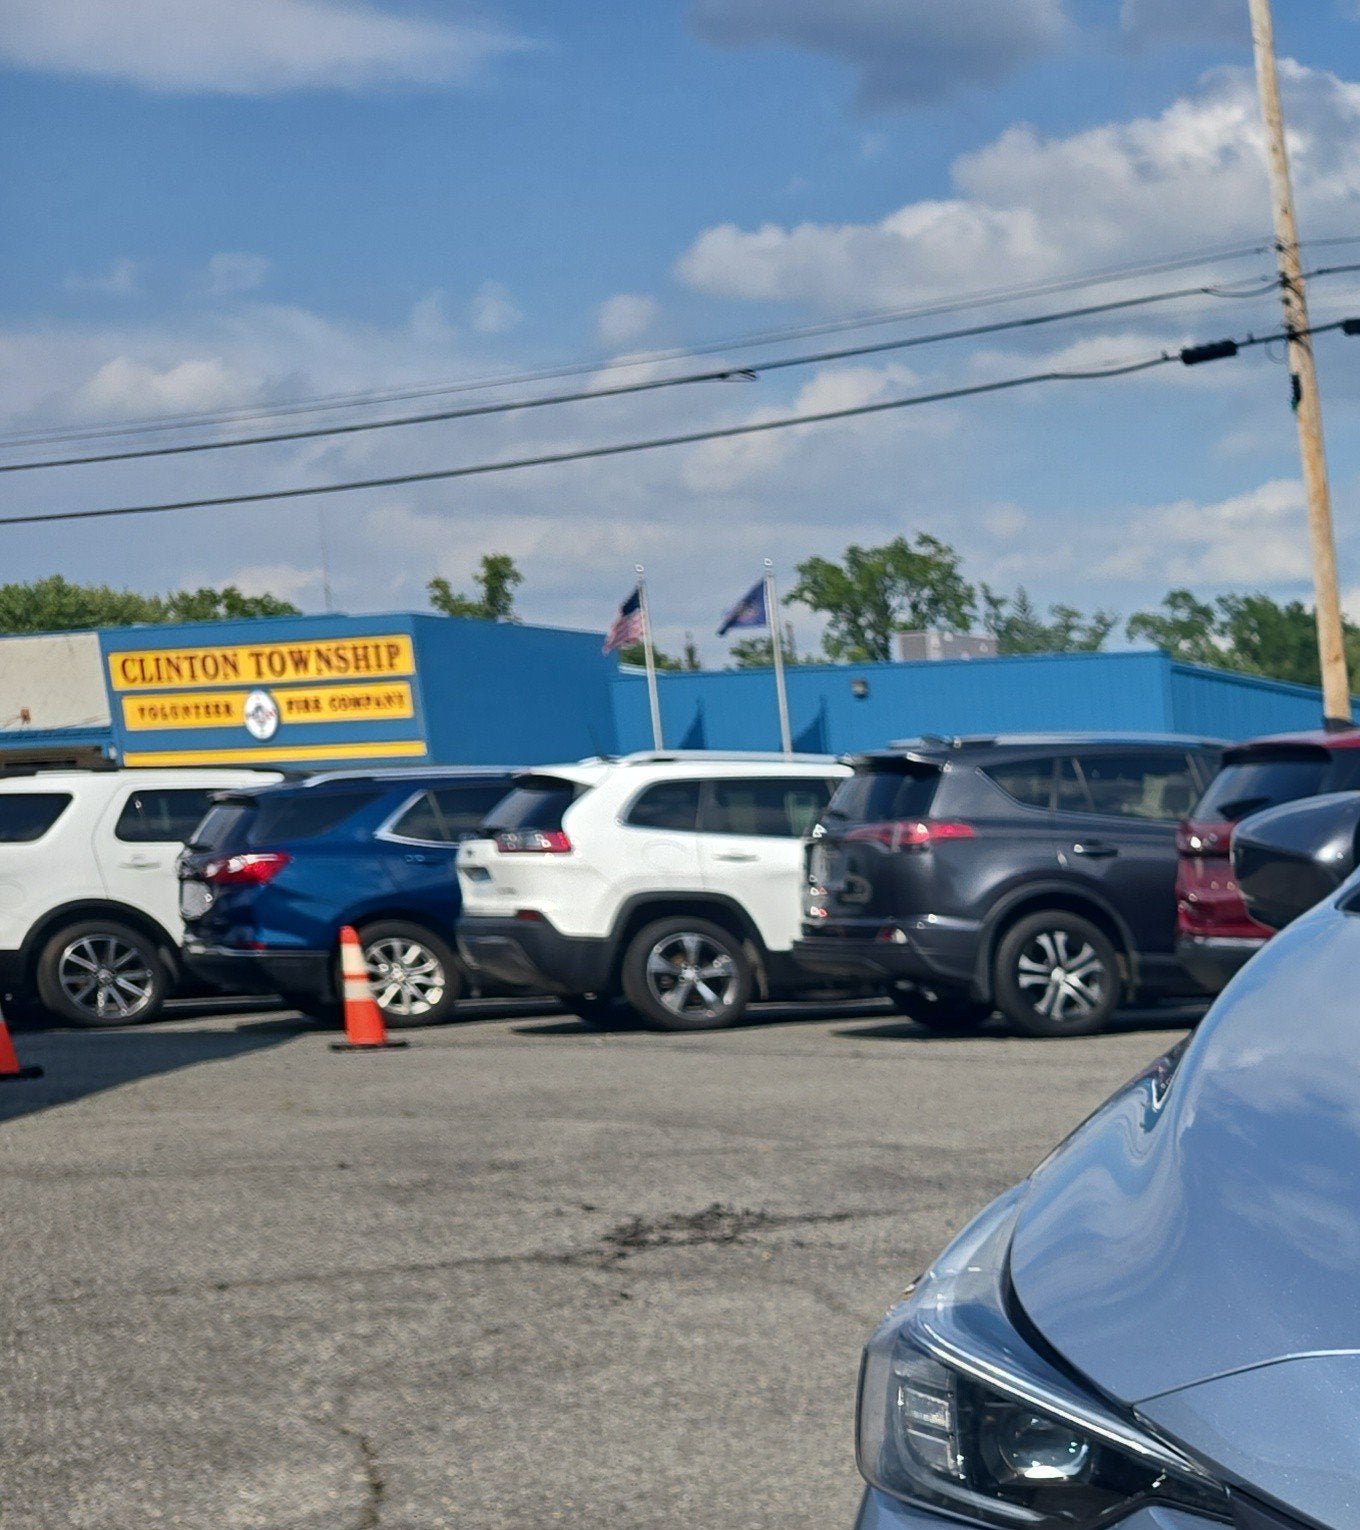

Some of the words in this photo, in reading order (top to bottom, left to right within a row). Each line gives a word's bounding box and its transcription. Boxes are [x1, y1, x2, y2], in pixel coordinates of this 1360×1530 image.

[120, 653, 241, 684] CLINTON
[249, 642, 402, 679] TOWNSHIP
[137, 700, 234, 722] VOLUNTEER
[285, 697, 322, 714] FIRE
[327, 693, 405, 713] COMPANY
